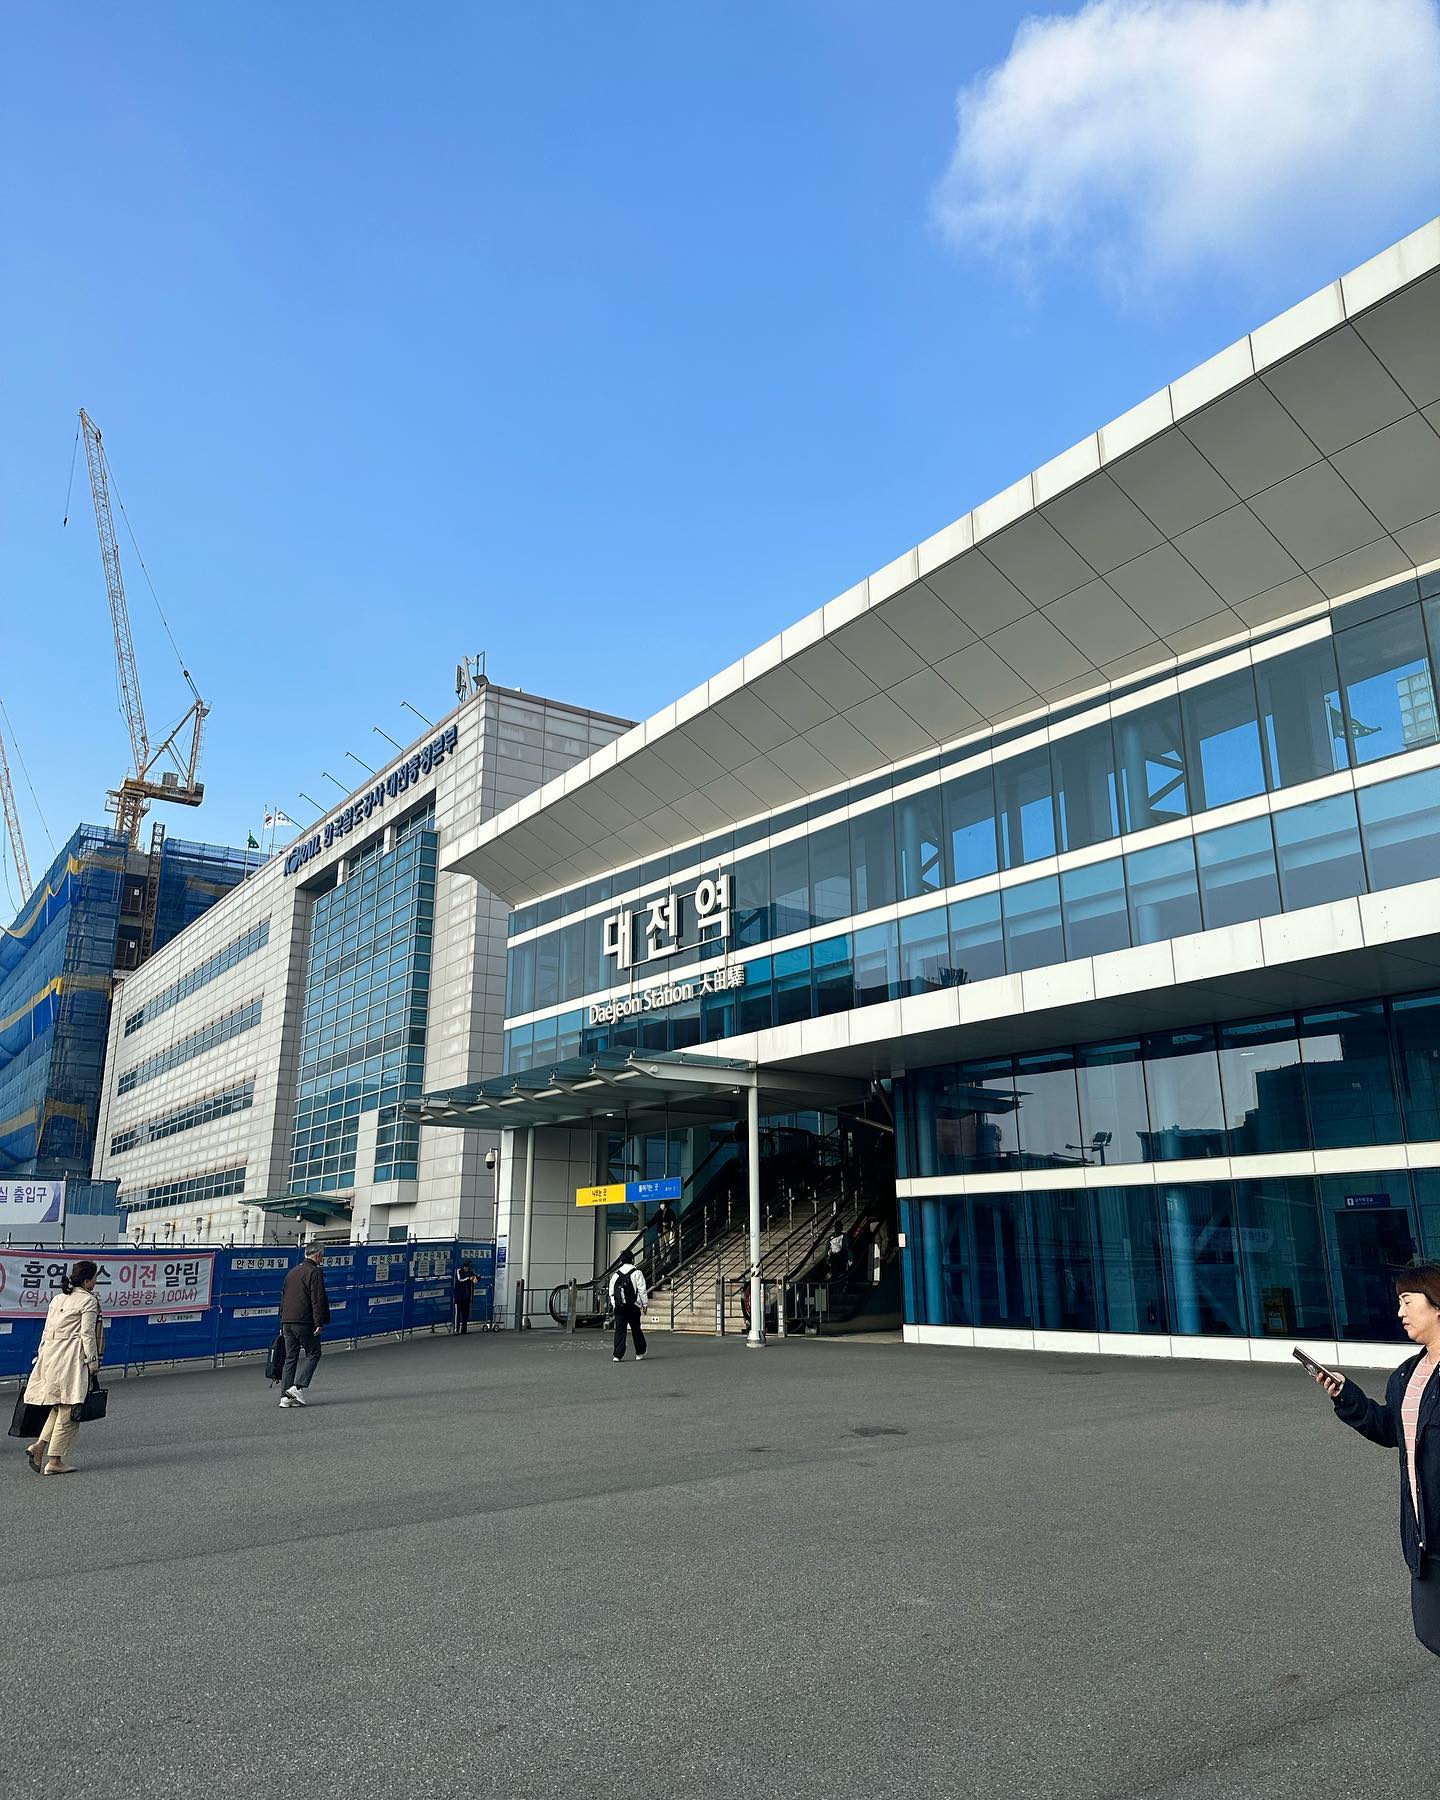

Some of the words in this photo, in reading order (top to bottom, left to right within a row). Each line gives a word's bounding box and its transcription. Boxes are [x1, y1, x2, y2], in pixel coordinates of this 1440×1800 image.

[603, 873, 731, 970] 대전역
[589, 997, 643, 1024] Daejeon
[643, 982, 694, 1011] Station
[14, 1186, 47, 1203] 출입구
[20, 1260, 112, 1289] 흡연스
[119, 1263, 158, 1288] 이전
[164, 1261, 200, 1288] 알림
[105, 1290, 157, 1307] 시장방향
[161, 1289, 198, 1303] 100M)
